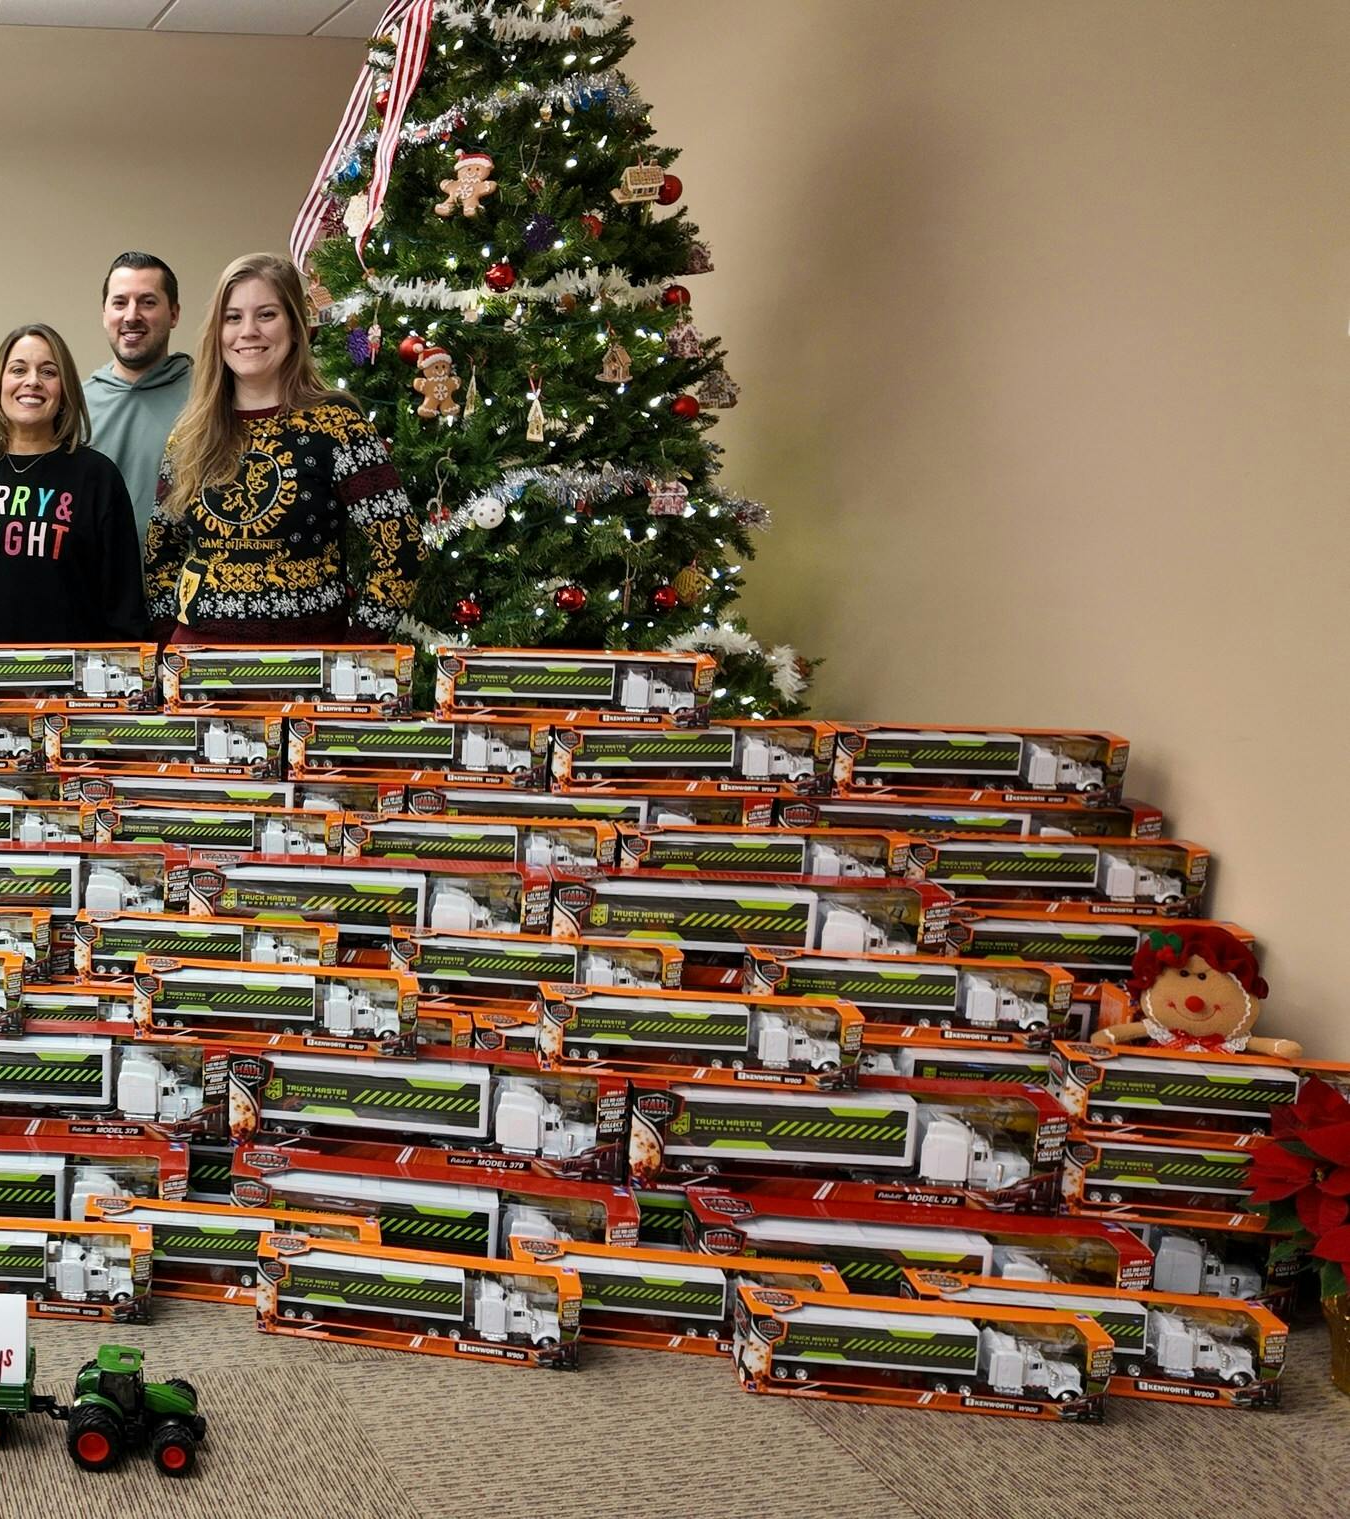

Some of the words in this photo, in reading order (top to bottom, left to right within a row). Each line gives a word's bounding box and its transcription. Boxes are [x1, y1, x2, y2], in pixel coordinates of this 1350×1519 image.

[55, 491, 73, 522] &
[197, 537, 225, 549] GAME
[613, 909, 640, 918] TRUCK
[286, 1084, 313, 1093] TRUCK
[695, 1118, 724, 1126] TRUCK
[96, 1126, 123, 1134] MODEL
[477, 1159, 508, 1168] MODEL
[509, 1162, 525, 1170] 379
[906, 1194, 940, 1204] MODEL
[940, 1196, 958, 1205] 379
